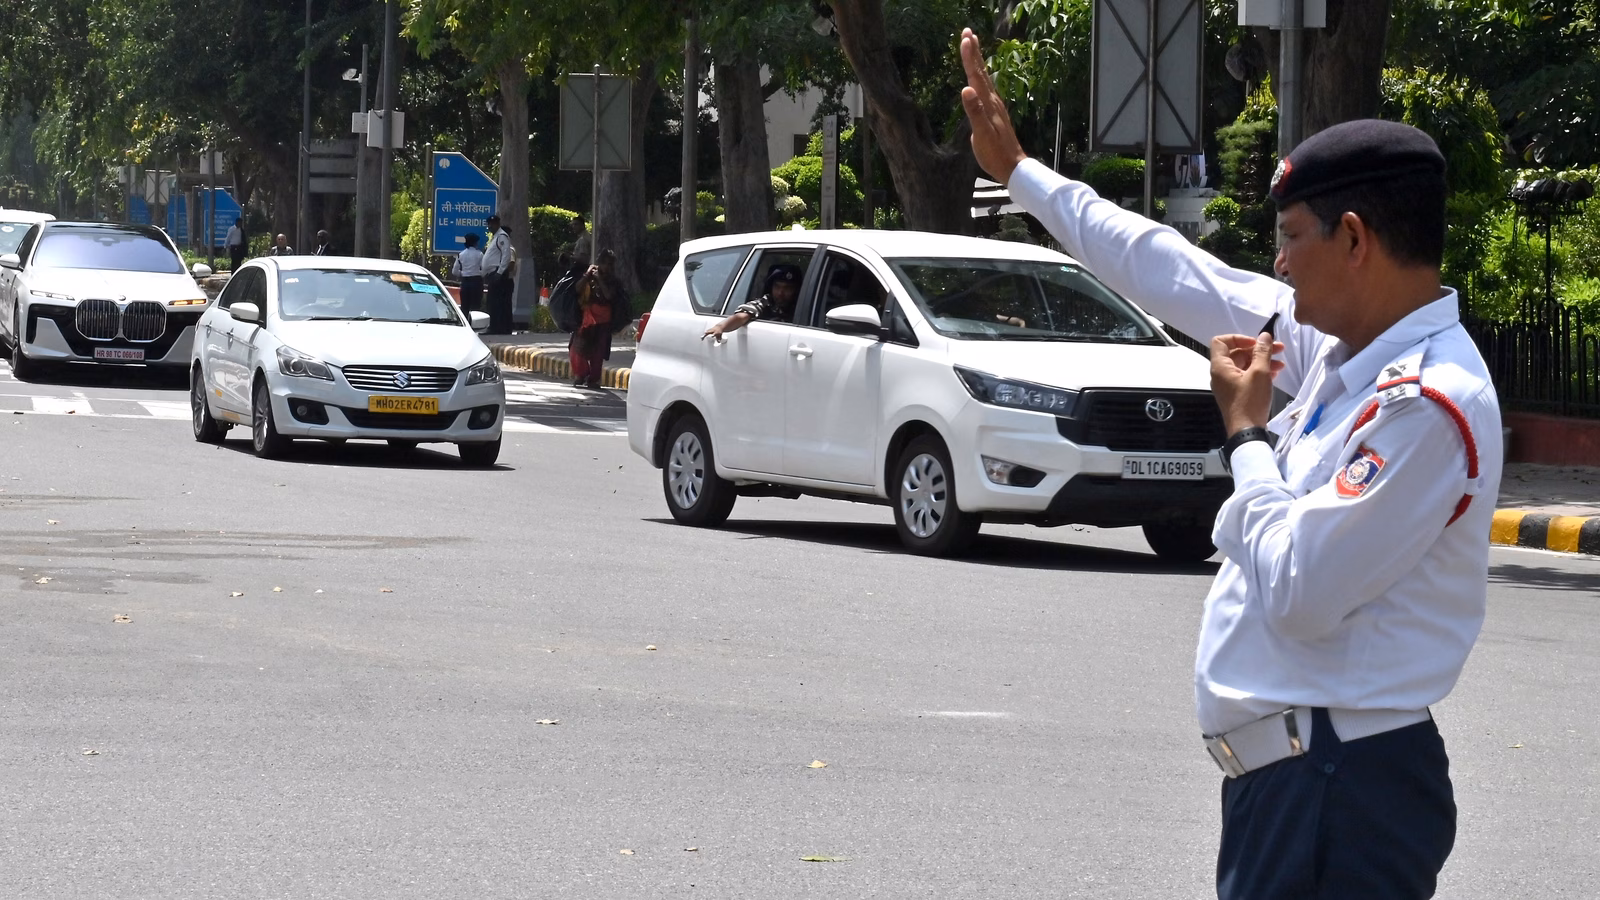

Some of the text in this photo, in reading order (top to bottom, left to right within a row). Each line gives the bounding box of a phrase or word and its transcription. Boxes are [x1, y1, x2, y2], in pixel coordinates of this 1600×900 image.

[441, 201, 491, 213] ली-मेरीडियन
[439, 218, 449, 226] LE
[455, 218, 488, 227] MERIDIE
[376, 399, 435, 411] MH02ER4781
[1131, 461, 1203, 475] DL1CAG9059
